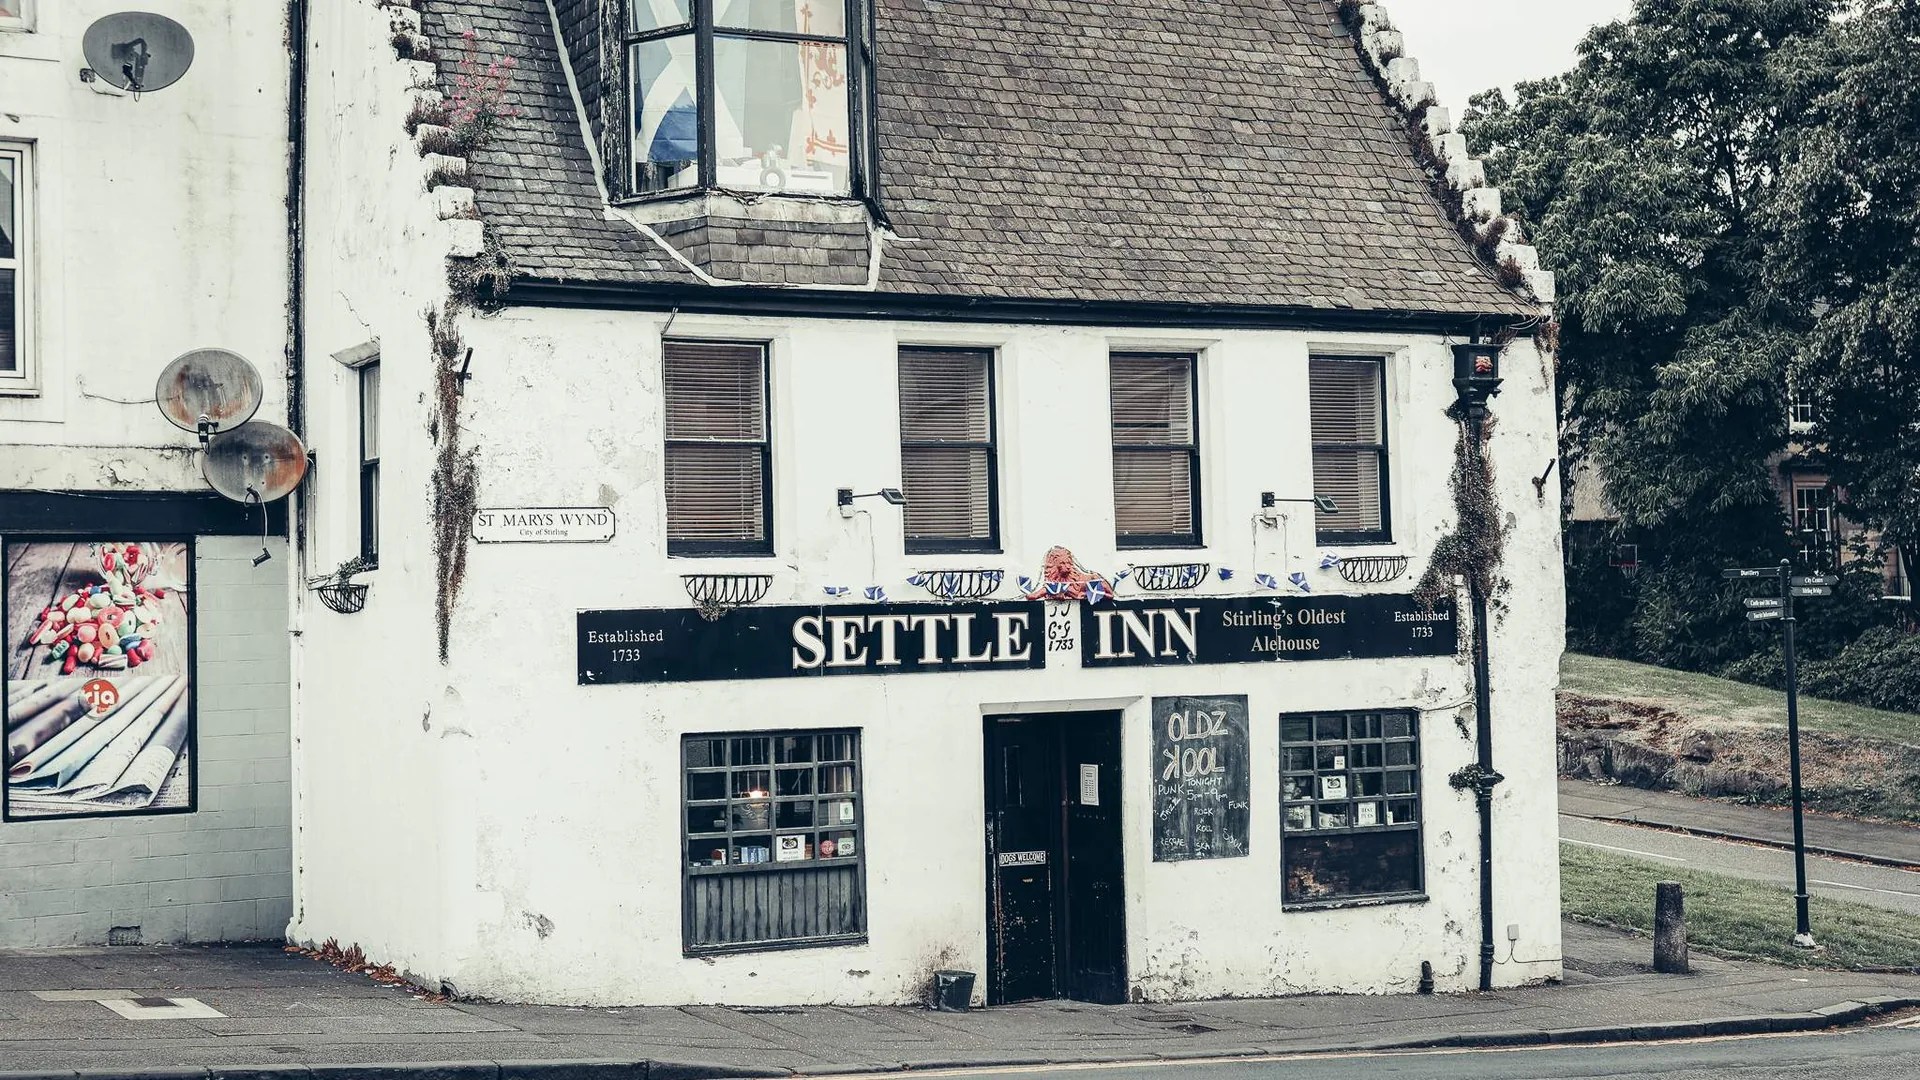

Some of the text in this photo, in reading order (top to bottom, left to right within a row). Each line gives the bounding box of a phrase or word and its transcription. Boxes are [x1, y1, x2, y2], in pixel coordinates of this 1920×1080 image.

[478, 513, 608, 526] ST MARYS WYND
[520, 528, 568, 536] City of Stirling
[1223, 609, 1346, 629] Stirling's Oldest
[1395, 610, 1449, 622] Established
[588, 629, 664, 643] Established
[792, 607, 1200, 670] SETTLE INN
[1411, 627, 1433, 638] 1733
[1048, 638, 1074, 651] 1733
[1251, 636, 1320, 652] Alehouse
[612, 649, 641, 662] 1733
[1168, 710, 1229, 742] OLDZ
[1185, 777, 1223, 787] TONIGHT
[1158, 784, 1185, 795] PUNK
[1194, 807, 1214, 816] ROCK
[1228, 801, 1249, 811] FUNK
[1195, 823, 1213, 833] ROLL
[1222, 828, 1243, 854] SOUL
[1017, 852, 1044, 863] WELCOME
